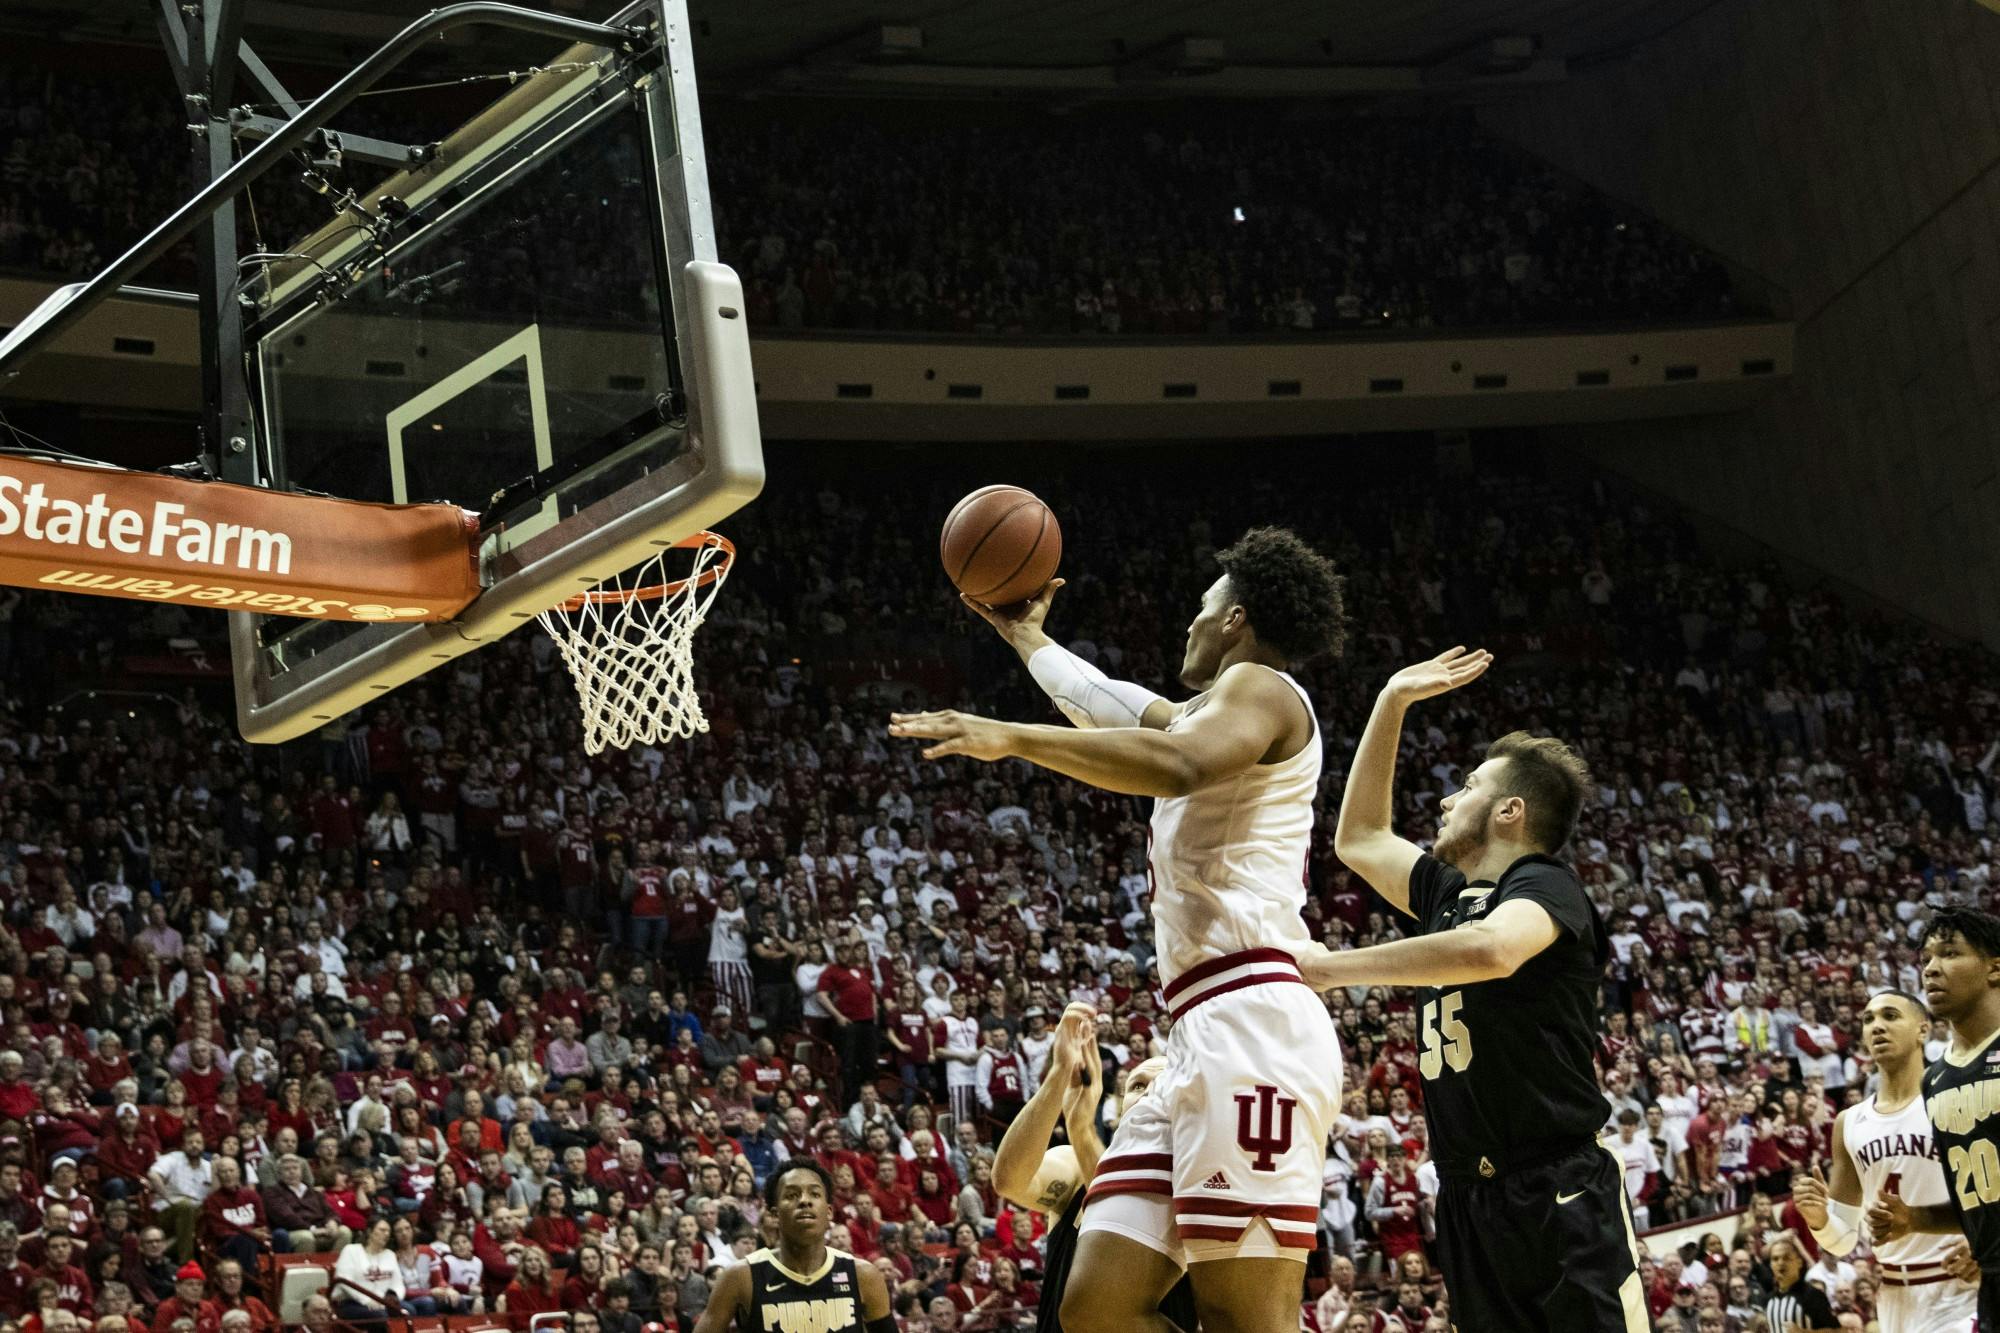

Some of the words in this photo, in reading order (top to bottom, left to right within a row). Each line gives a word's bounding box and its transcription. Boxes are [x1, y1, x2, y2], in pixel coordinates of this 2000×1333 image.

[1419, 990, 1473, 1081] 55
[1203, 1182, 1231, 1190] adidas
[1948, 1138, 2000, 1211] 20
[761, 1297, 857, 1333] PURDUE
